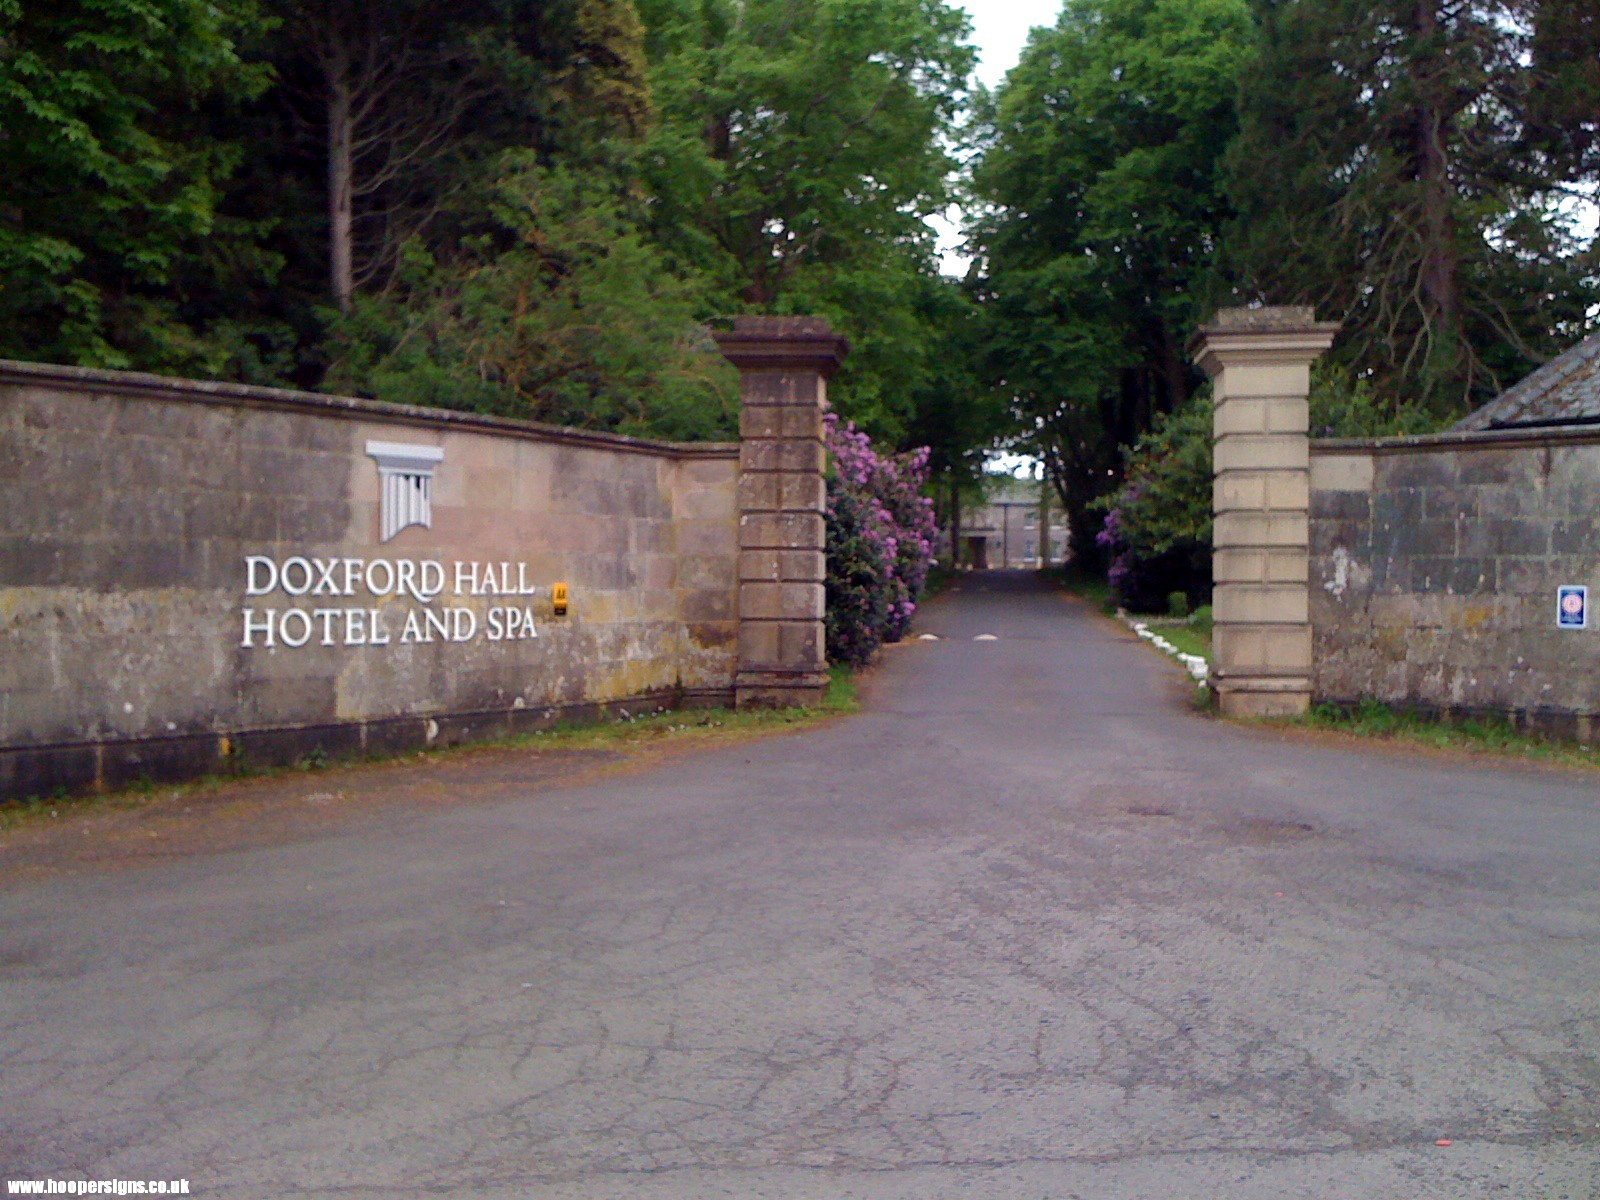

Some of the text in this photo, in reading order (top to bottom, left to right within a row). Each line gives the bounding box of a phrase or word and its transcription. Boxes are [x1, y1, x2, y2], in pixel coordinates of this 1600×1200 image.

[245, 555, 535, 602] DOXFORD HALL
[241, 606, 538, 648] HOTEL AND SPA
